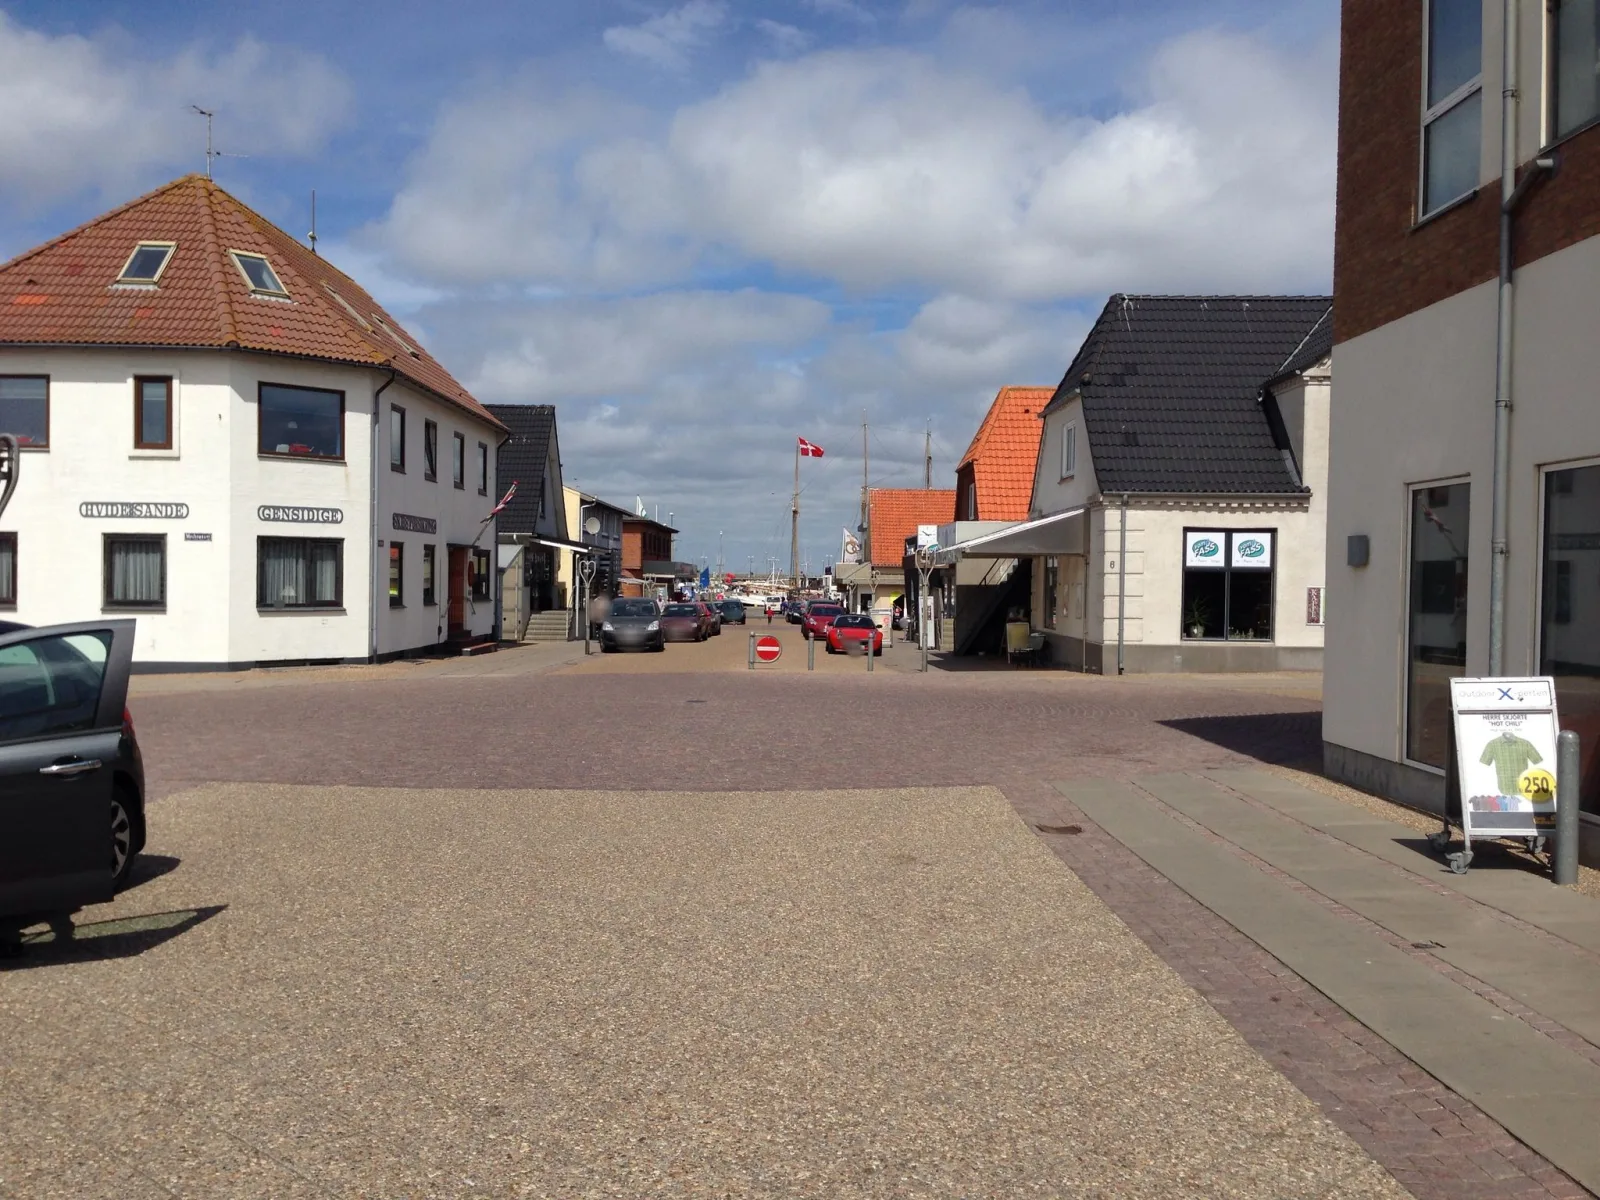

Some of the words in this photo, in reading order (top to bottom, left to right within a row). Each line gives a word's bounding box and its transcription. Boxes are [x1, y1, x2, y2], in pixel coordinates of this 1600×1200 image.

[85, 503, 129, 518] HVIDE
[133, 504, 185, 519] SANDE
[262, 506, 342, 523] GENSIDIGE
[1194, 543, 1216, 558] FASS
[1240, 543, 1262, 558] FASS
[1459, 690, 1495, 698] Outdoor
